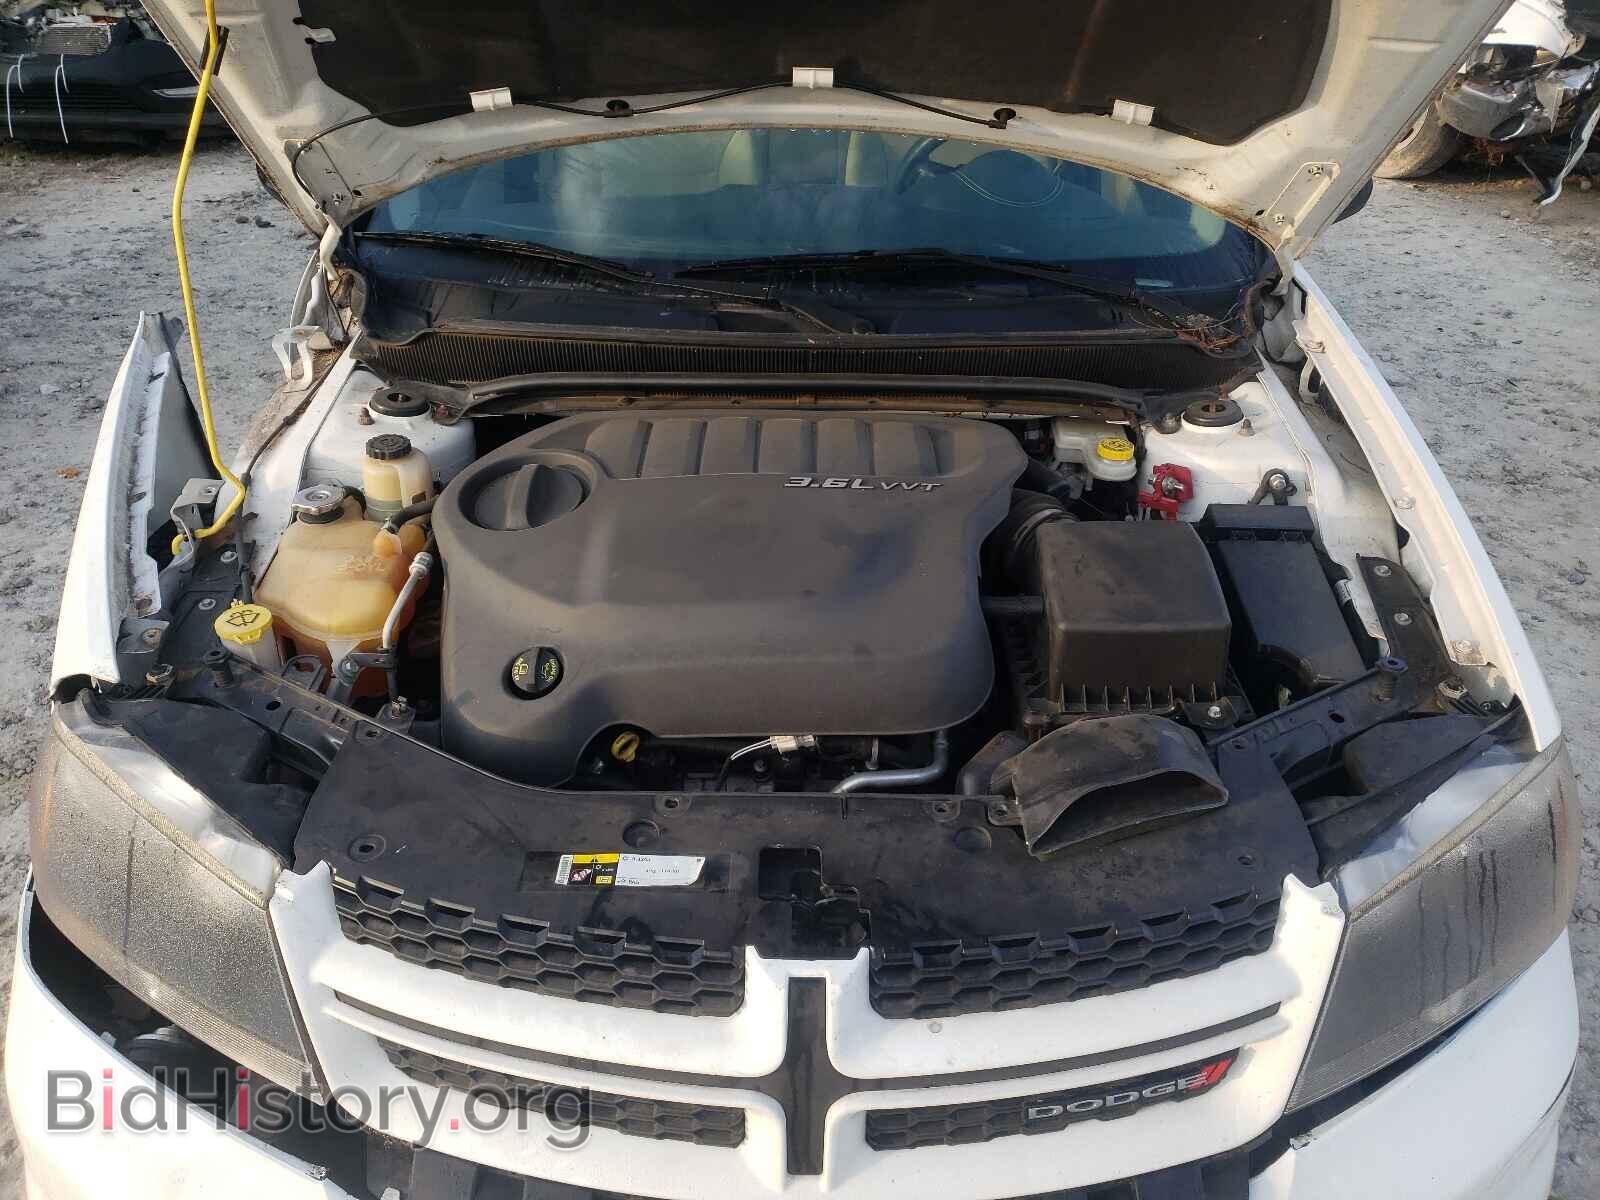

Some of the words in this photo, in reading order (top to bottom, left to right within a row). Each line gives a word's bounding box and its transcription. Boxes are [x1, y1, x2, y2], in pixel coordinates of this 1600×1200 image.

[784, 476, 874, 490] 3.6L
[880, 482, 943, 491] VVT
[1027, 1071, 1208, 1120] DODGE
